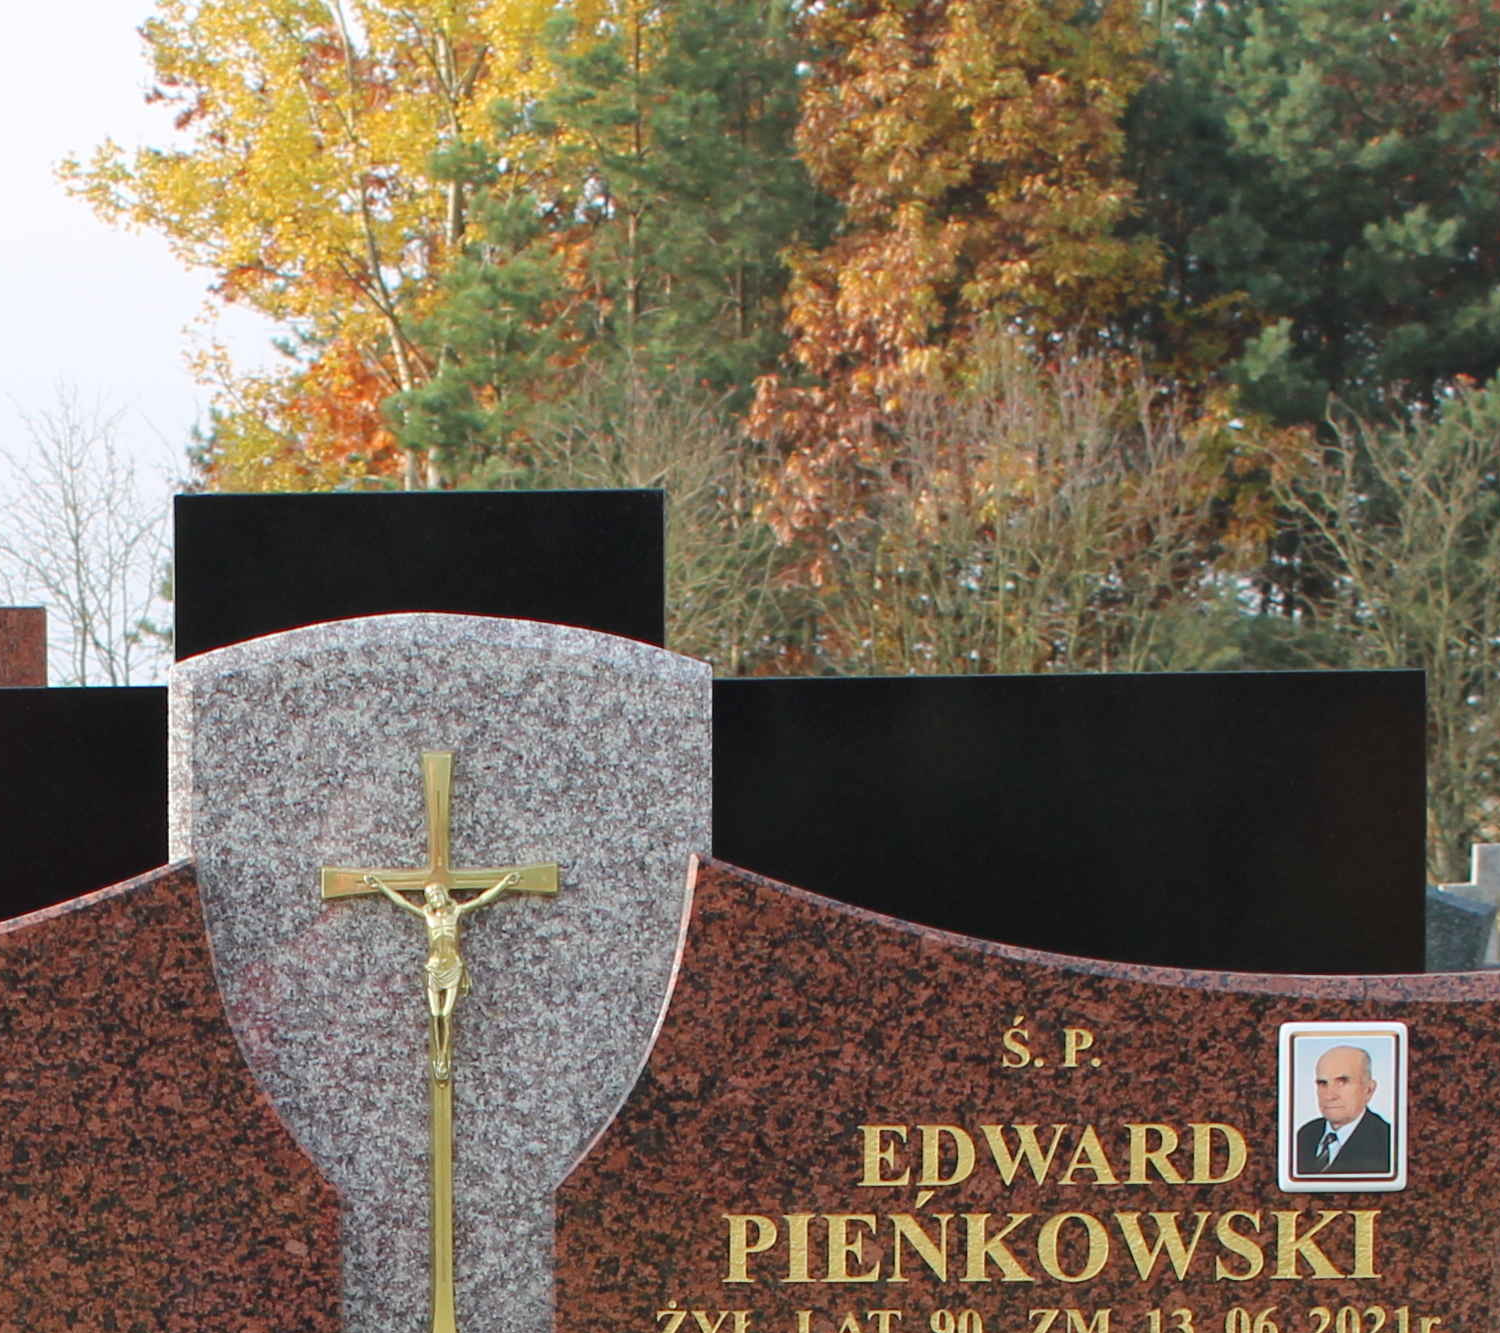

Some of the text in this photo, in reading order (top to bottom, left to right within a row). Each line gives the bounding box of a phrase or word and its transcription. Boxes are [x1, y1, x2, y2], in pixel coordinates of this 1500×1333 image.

[1001, 1016, 1103, 1069] Ś. P.
[856, 1122, 1249, 1189] EDWARD
[719, 1191, 1384, 1284] PIEŃKOWSKI
